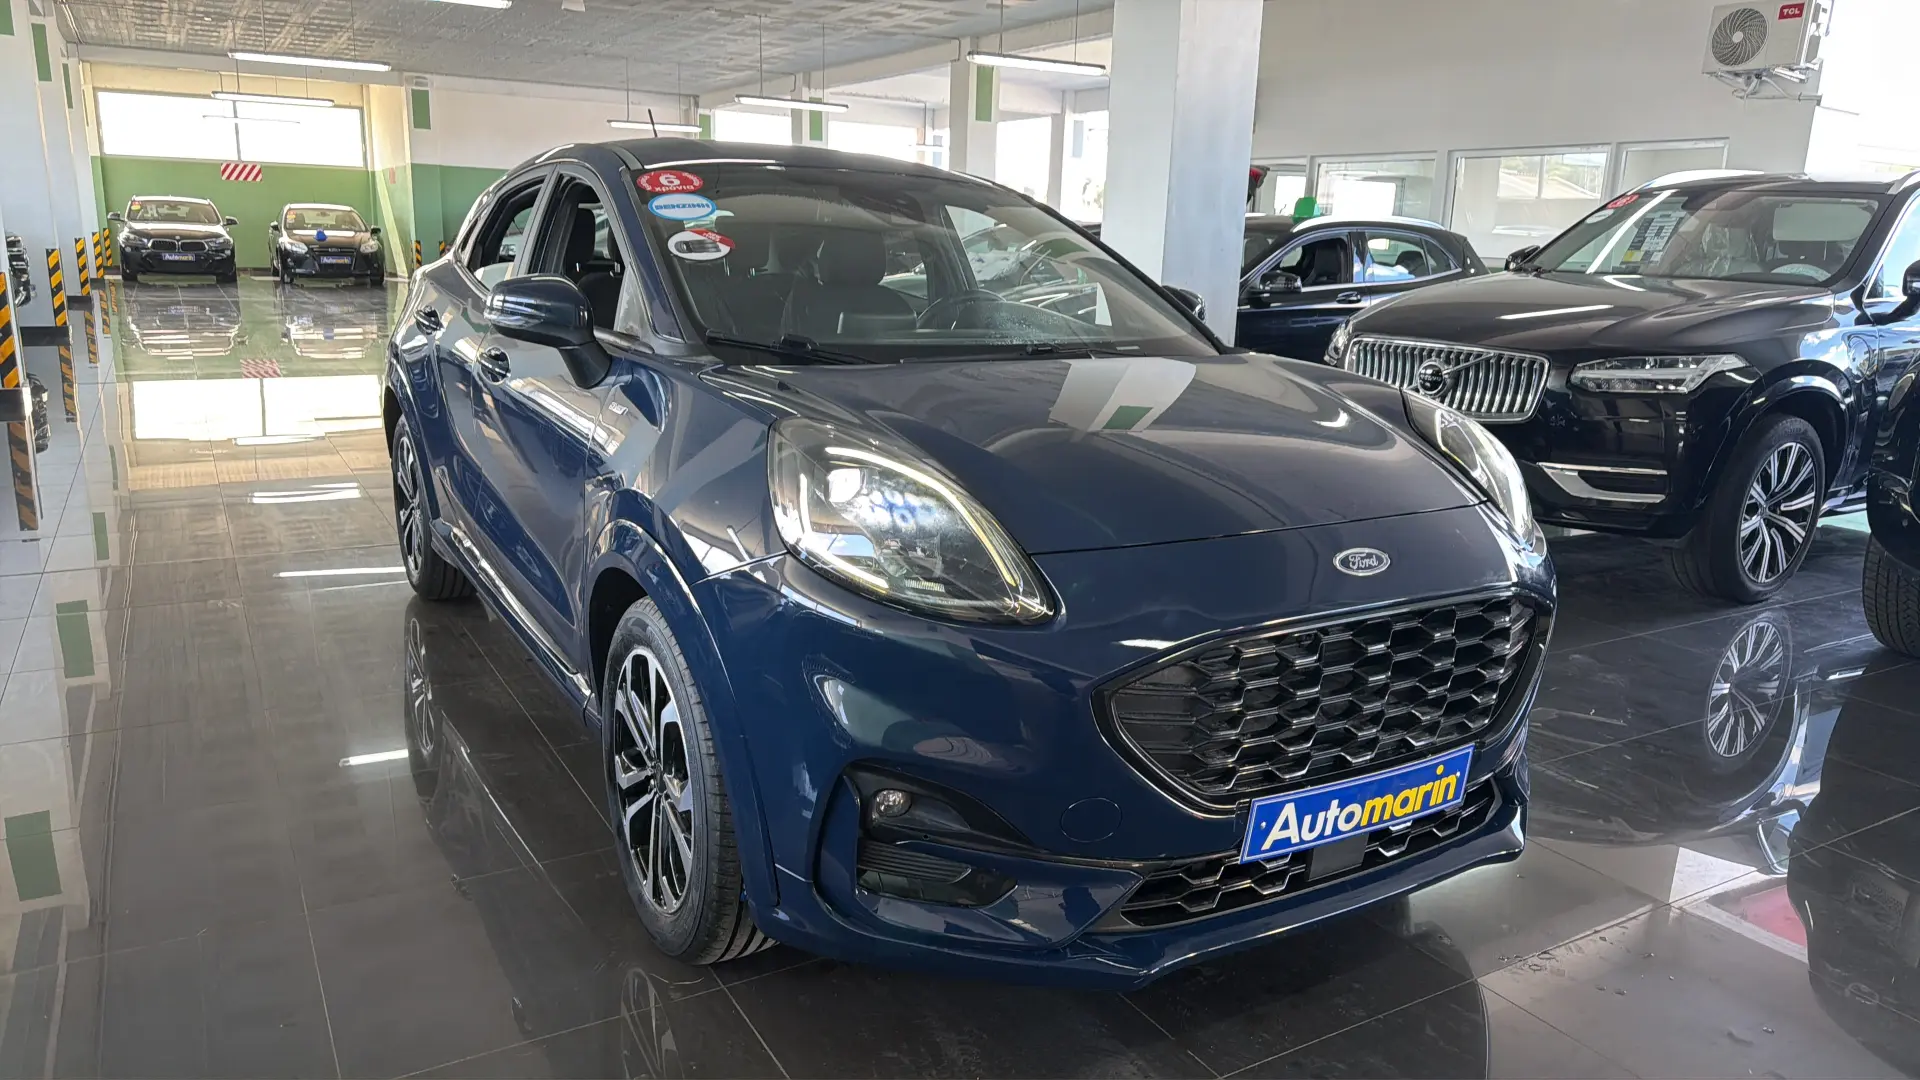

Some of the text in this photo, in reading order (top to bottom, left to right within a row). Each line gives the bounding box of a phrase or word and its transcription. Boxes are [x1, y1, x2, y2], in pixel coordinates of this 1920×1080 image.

[1783, 7, 1800, 16] TCL
[659, 173, 681, 187] 6
[1348, 553, 1379, 570] Ford
[1261, 764, 1458, 851] Automarin
